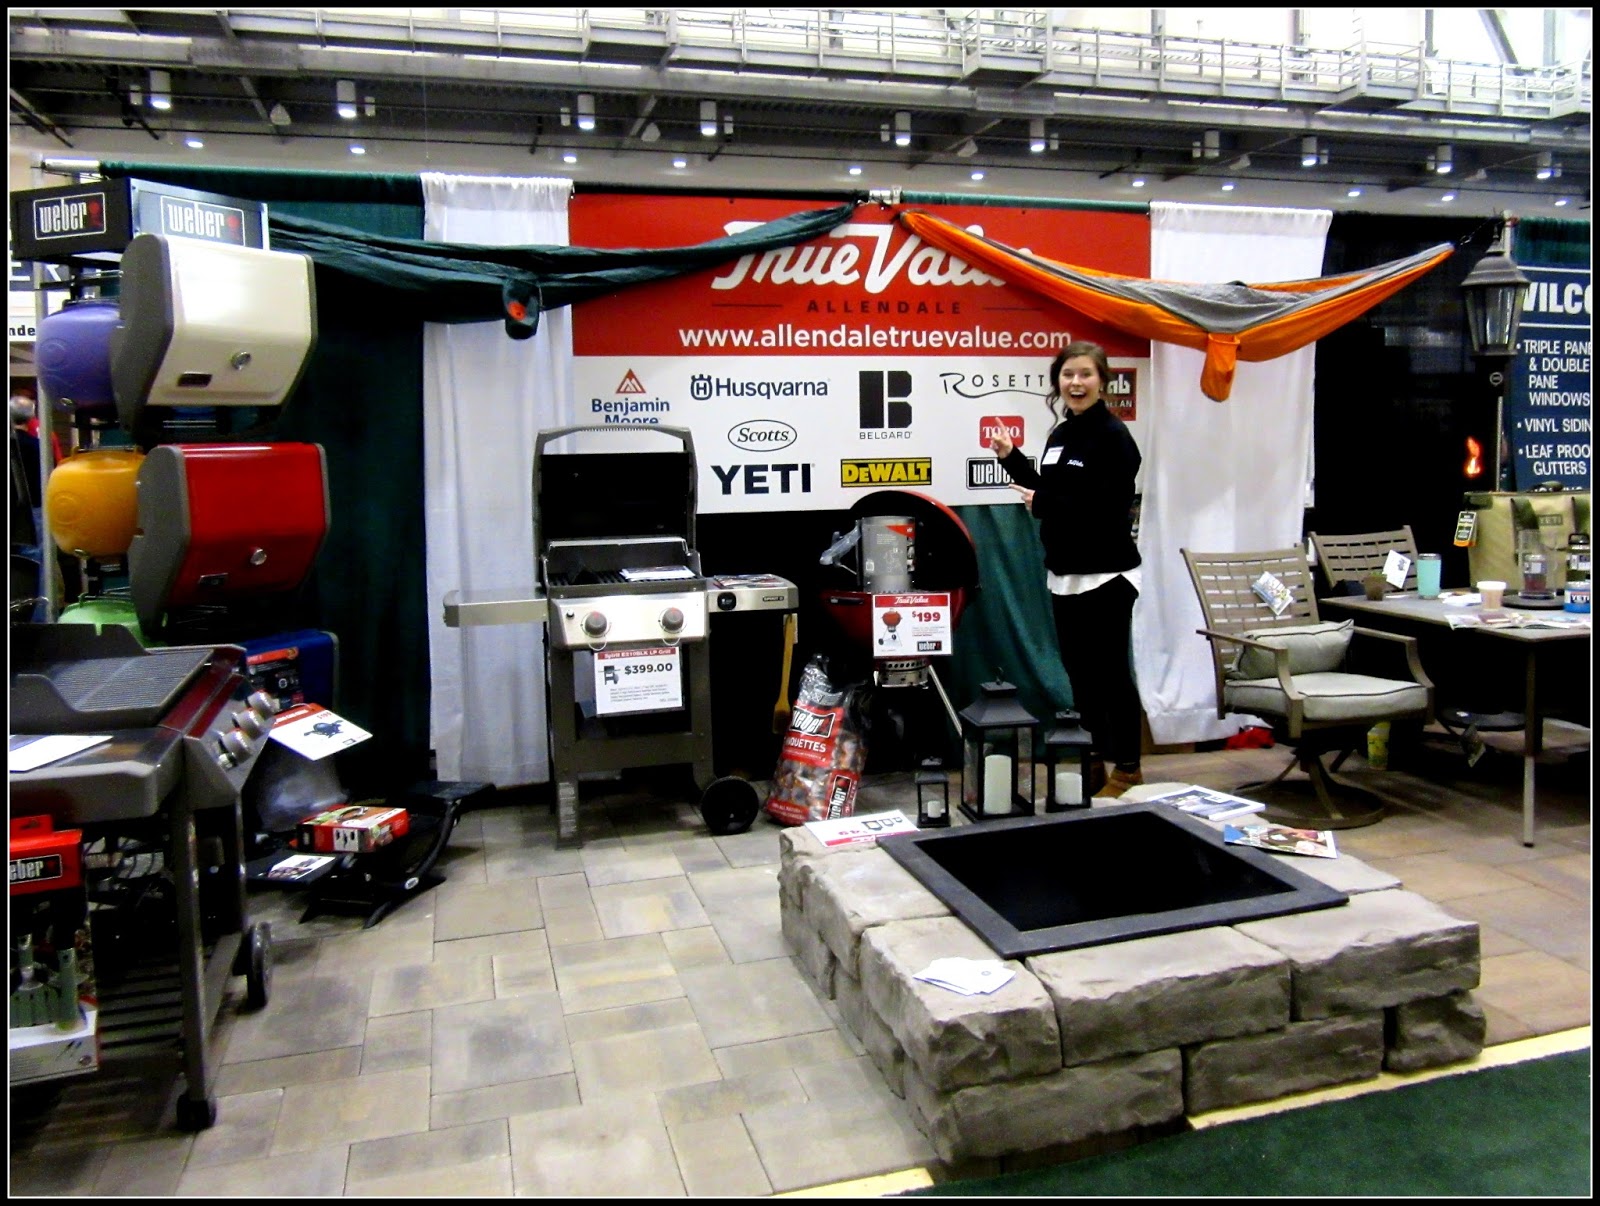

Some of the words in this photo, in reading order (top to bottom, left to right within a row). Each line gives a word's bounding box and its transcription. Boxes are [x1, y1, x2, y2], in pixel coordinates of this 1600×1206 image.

[39, 198, 87, 233] weber
[168, 201, 225, 239] weber
[806, 300, 961, 315] ALLENDALE
[679, 323, 1072, 350] www.allendaletruevalue.com
[1524, 339, 1561, 355] TRIPLE
[1529, 357, 1538, 372] &
[1542, 357, 1590, 372] DOUBLE
[715, 377, 828, 399] Husqvarna
[1529, 375, 1558, 389] PANE
[591, 398, 670, 415] Benjamin
[1529, 392, 1590, 407] WINDOWS
[1525, 418, 1559, 432] VINYL
[737, 427, 789, 442] Scotts
[859, 431, 911, 440] BELGARD
[1525, 444, 1553, 458] LEAF
[1533, 461, 1587, 475] GUTTERS
[710, 463, 812, 495] YETI
[912, 611, 941, 622] $199
[918, 641, 936, 651] weber
[624, 662, 673, 675] $399.00
